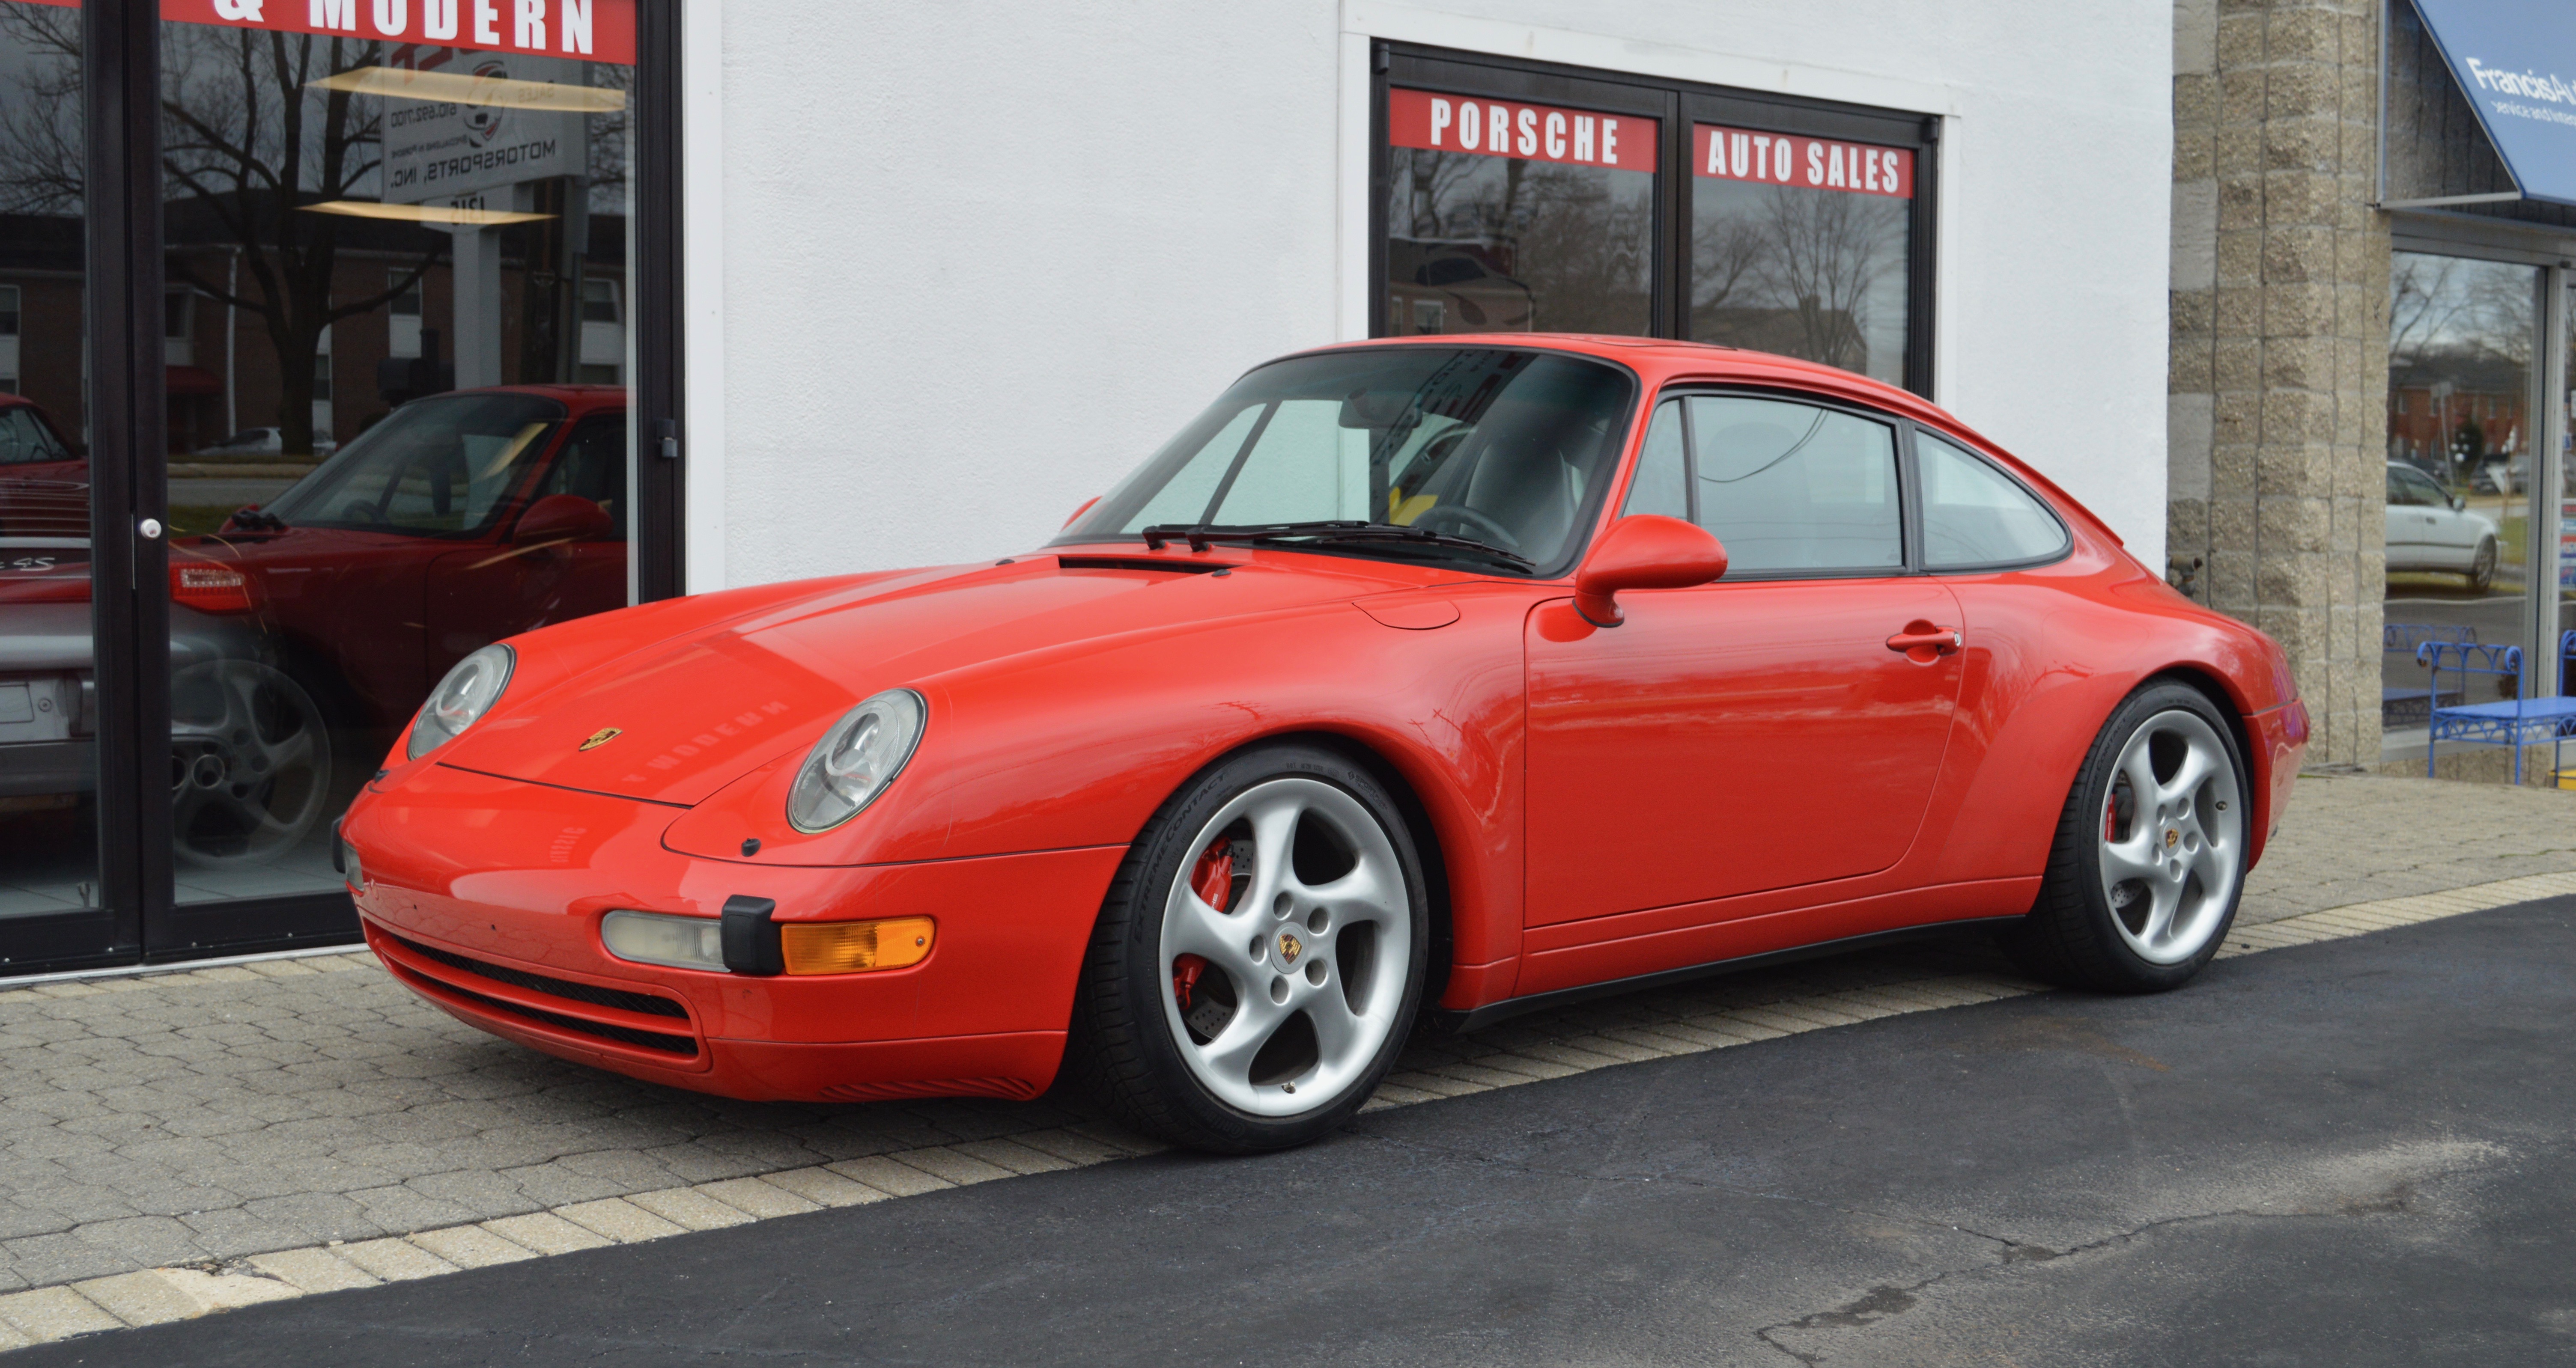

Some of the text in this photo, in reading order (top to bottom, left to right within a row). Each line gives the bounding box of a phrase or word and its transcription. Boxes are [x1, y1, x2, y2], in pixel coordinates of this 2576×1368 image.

[1431, 98, 1618, 164] PORSCHE
[1707, 131, 1899, 193] AUTO SALES
